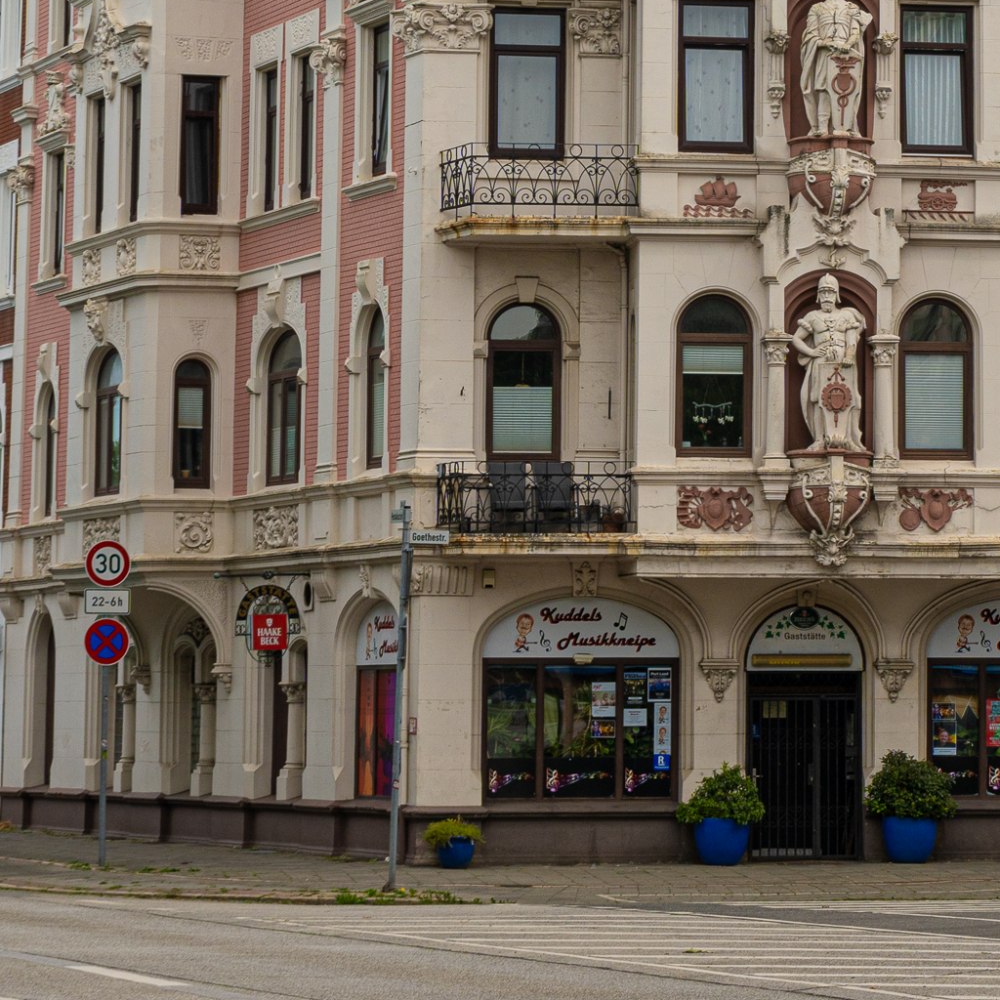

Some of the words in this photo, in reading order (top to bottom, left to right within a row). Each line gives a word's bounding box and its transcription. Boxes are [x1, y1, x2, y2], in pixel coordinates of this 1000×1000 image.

[412, 532, 447, 542] Goethestr.
[95, 553, 121, 574] 30
[540, 607, 602, 624] Kuddels
[257, 627, 282, 637] HAAKE
[783, 631, 826, 640] Gaststätte
[260, 637, 279, 646] BECK
[557, 632, 657, 652] Musikkneipe
